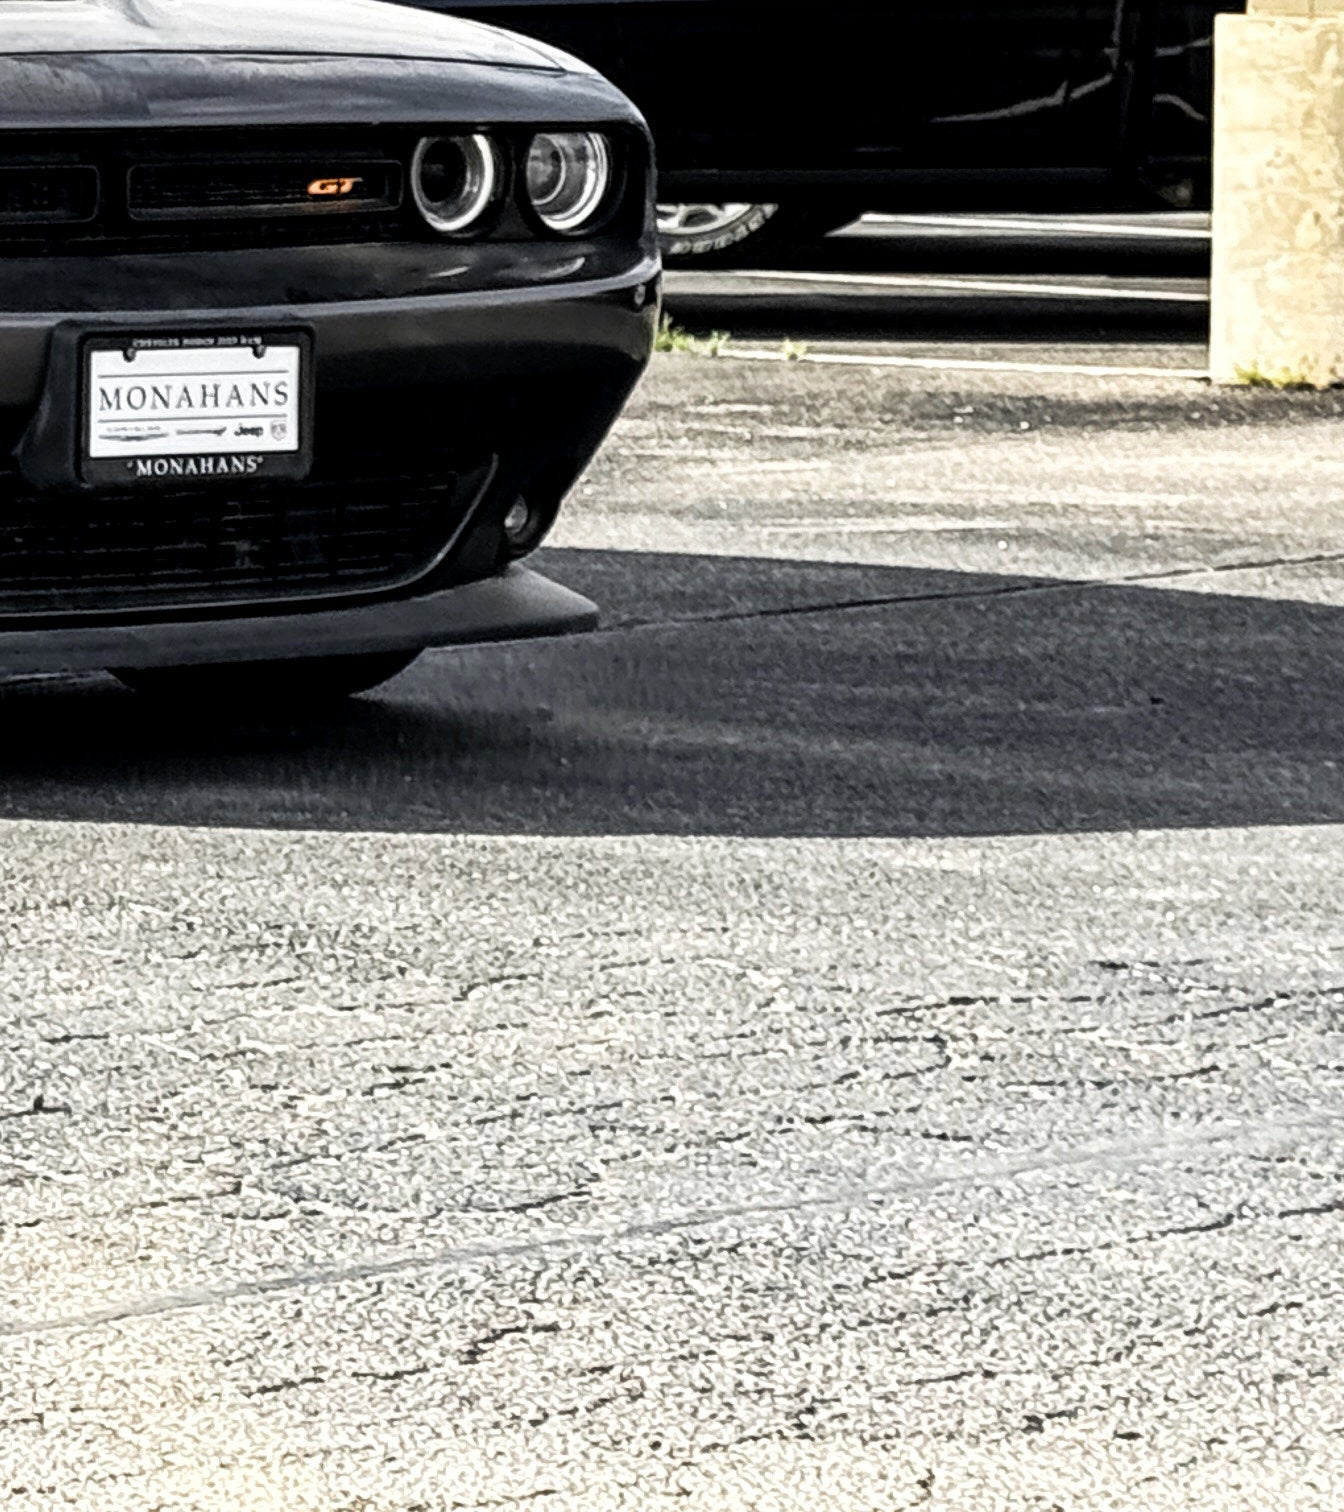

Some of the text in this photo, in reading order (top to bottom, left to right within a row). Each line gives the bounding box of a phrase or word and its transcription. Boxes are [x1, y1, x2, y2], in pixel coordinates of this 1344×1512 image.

[307, 177, 363, 195] GT
[99, 381, 289, 411] MONAHANS
[136, 455, 258, 477] MONAHANS
